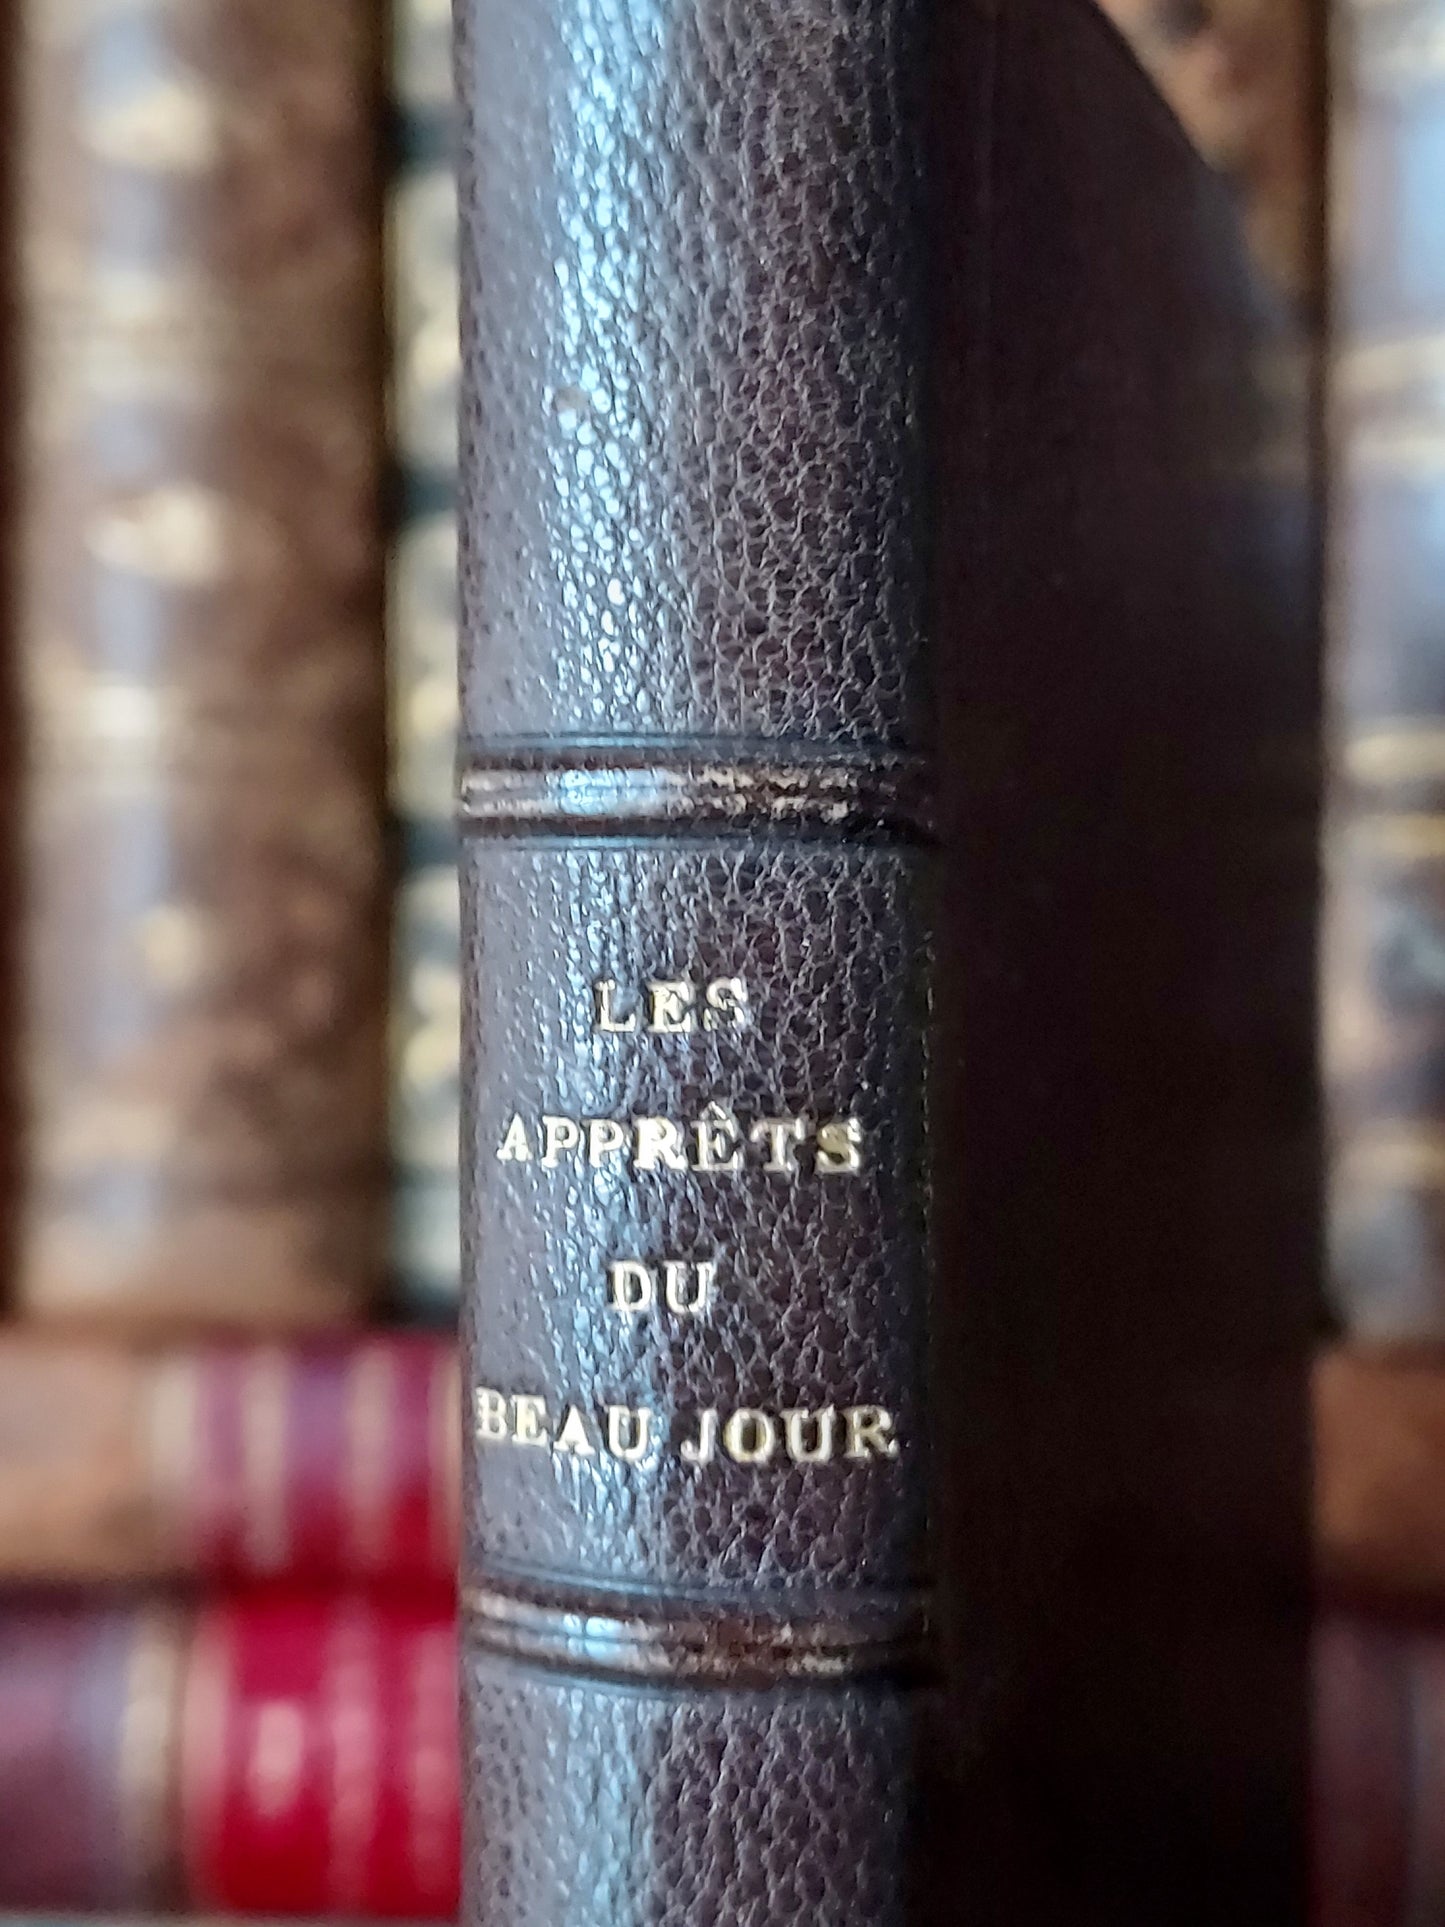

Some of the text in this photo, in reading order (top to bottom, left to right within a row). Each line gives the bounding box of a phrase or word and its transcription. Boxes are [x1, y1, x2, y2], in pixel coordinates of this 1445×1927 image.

[595, 977, 752, 1033] LES
[497, 1101, 864, 1174] APPRÊTS
[609, 1259, 717, 1315] DU
[474, 1387, 899, 1464] BEAU JOUR
